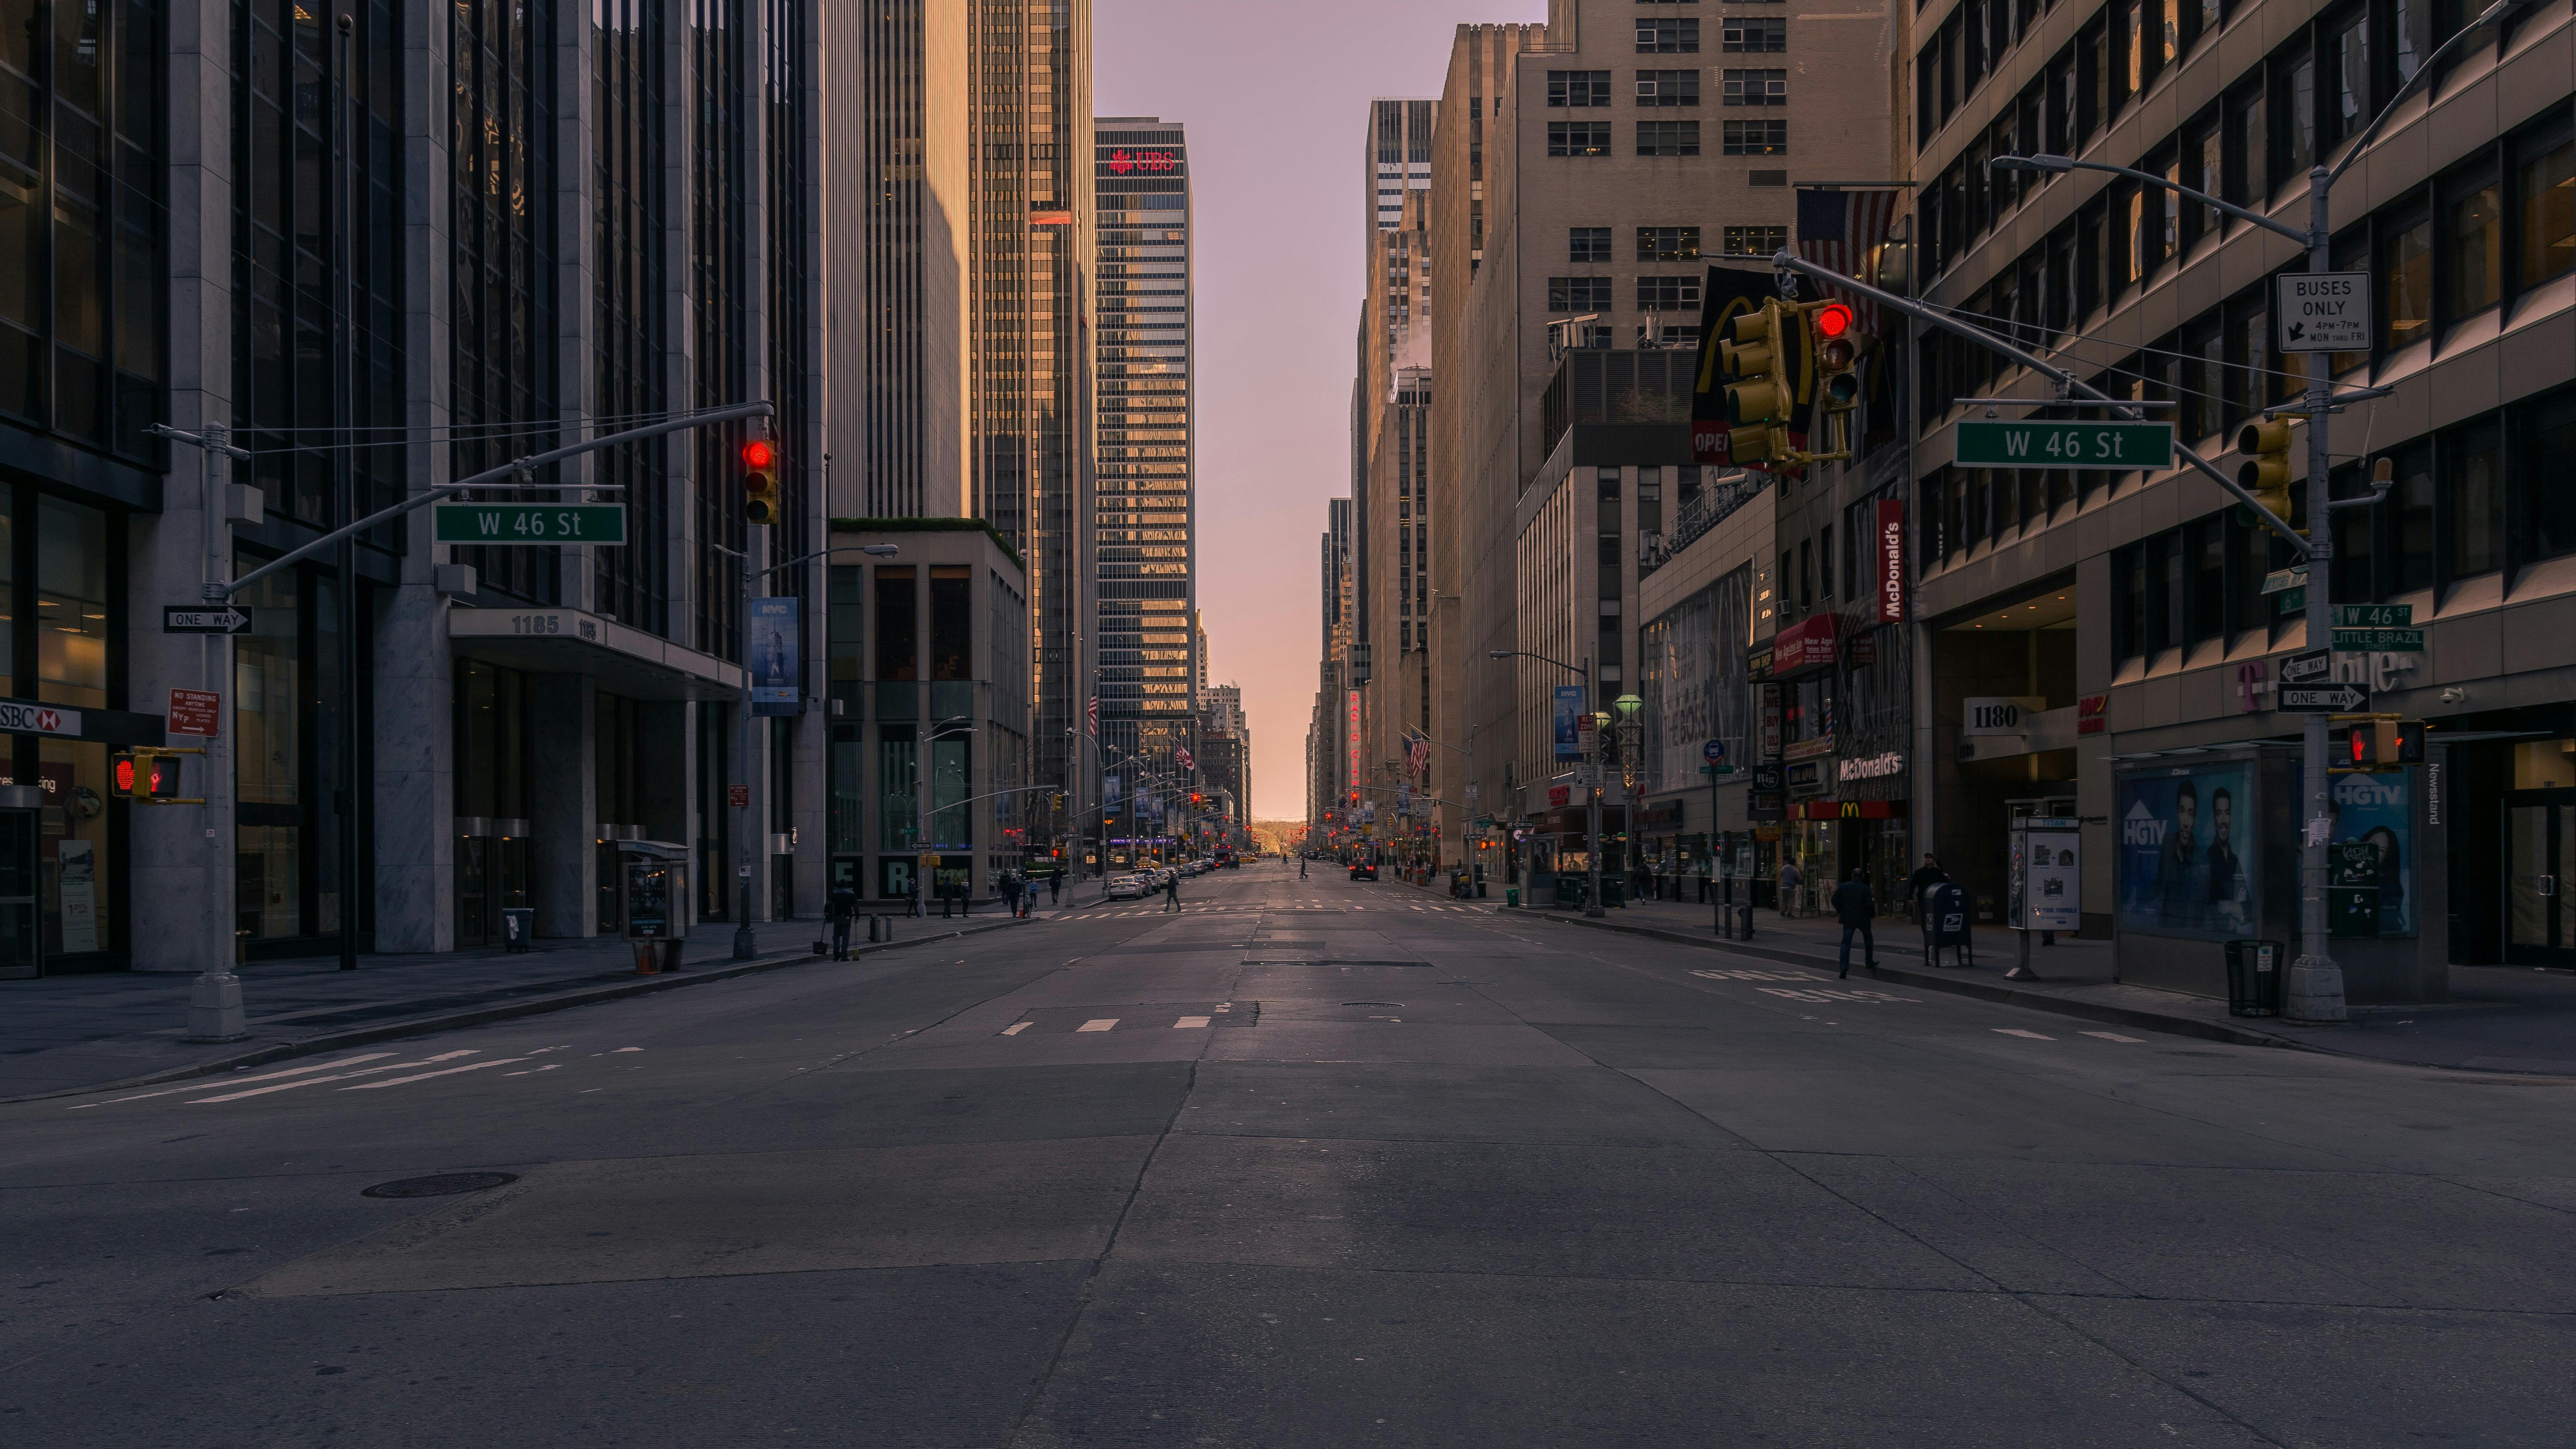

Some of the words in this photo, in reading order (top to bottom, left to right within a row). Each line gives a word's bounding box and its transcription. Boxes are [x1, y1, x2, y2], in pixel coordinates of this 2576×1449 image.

[1136, 152, 1174, 170] UBS
[2297, 281, 2351, 296] BUSES
[2303, 301, 2346, 316] ONLY
[2316, 321, 2359, 330] 4PM-7PM
[2310, 333, 2329, 342] MON
[2351, 332, 2365, 340] FRI
[2005, 431, 2030, 456] W
[2045, 431, 2081, 457] 46
[2096, 432, 2123, 458] St
[478, 513, 501, 535] W
[514, 513, 545, 535] 46
[558, 512, 581, 535] St
[1885, 522, 1900, 617] McDonald's
[762, 605, 788, 614] NYC
[2285, 593, 2291, 610] 6
[176, 614, 201, 625] ONE
[213, 614, 239, 625] WAY
[2347, 608, 2360, 624] W
[2369, 608, 2392, 624] 46
[2397, 608, 2408, 617] ST
[512, 616, 559, 634] 1185
[579, 619, 596, 641] 1185
[1821, 637, 1833, 646] Age
[2333, 632, 2372, 643] LITTLE
[2379, 632, 2422, 644] BRAZIL
[2287, 664, 2300, 677] ONE
[2308, 658, 2324, 671] WAY
[186, 693, 216, 702] STANDING
[1765, 696, 1780, 708] WE
[2291, 693, 2317, 703] ONE
[2330, 693, 2357, 704] WAY
[172, 711, 189, 723] NYP
[1351, 693, 1359, 741] RADIO
[1766, 716, 1779, 727] BUY
[1974, 705, 2017, 728] 1180
[1766, 735, 1779, 746] GOLD
[1959, 743, 1975, 759] 1180
[1351, 750, 1359, 786] CITY
[1840, 752, 1900, 781] McDonald's
[1757, 773, 1776, 785] Big
[2334, 785, 2401, 805] HGTV
[2429, 763, 2440, 825] Newsstand
[2123, 820, 2168, 845] HGTV
[835, 862, 854, 890] E
[887, 861, 909, 894] R
[1754, 987, 1924, 1004] BUS
